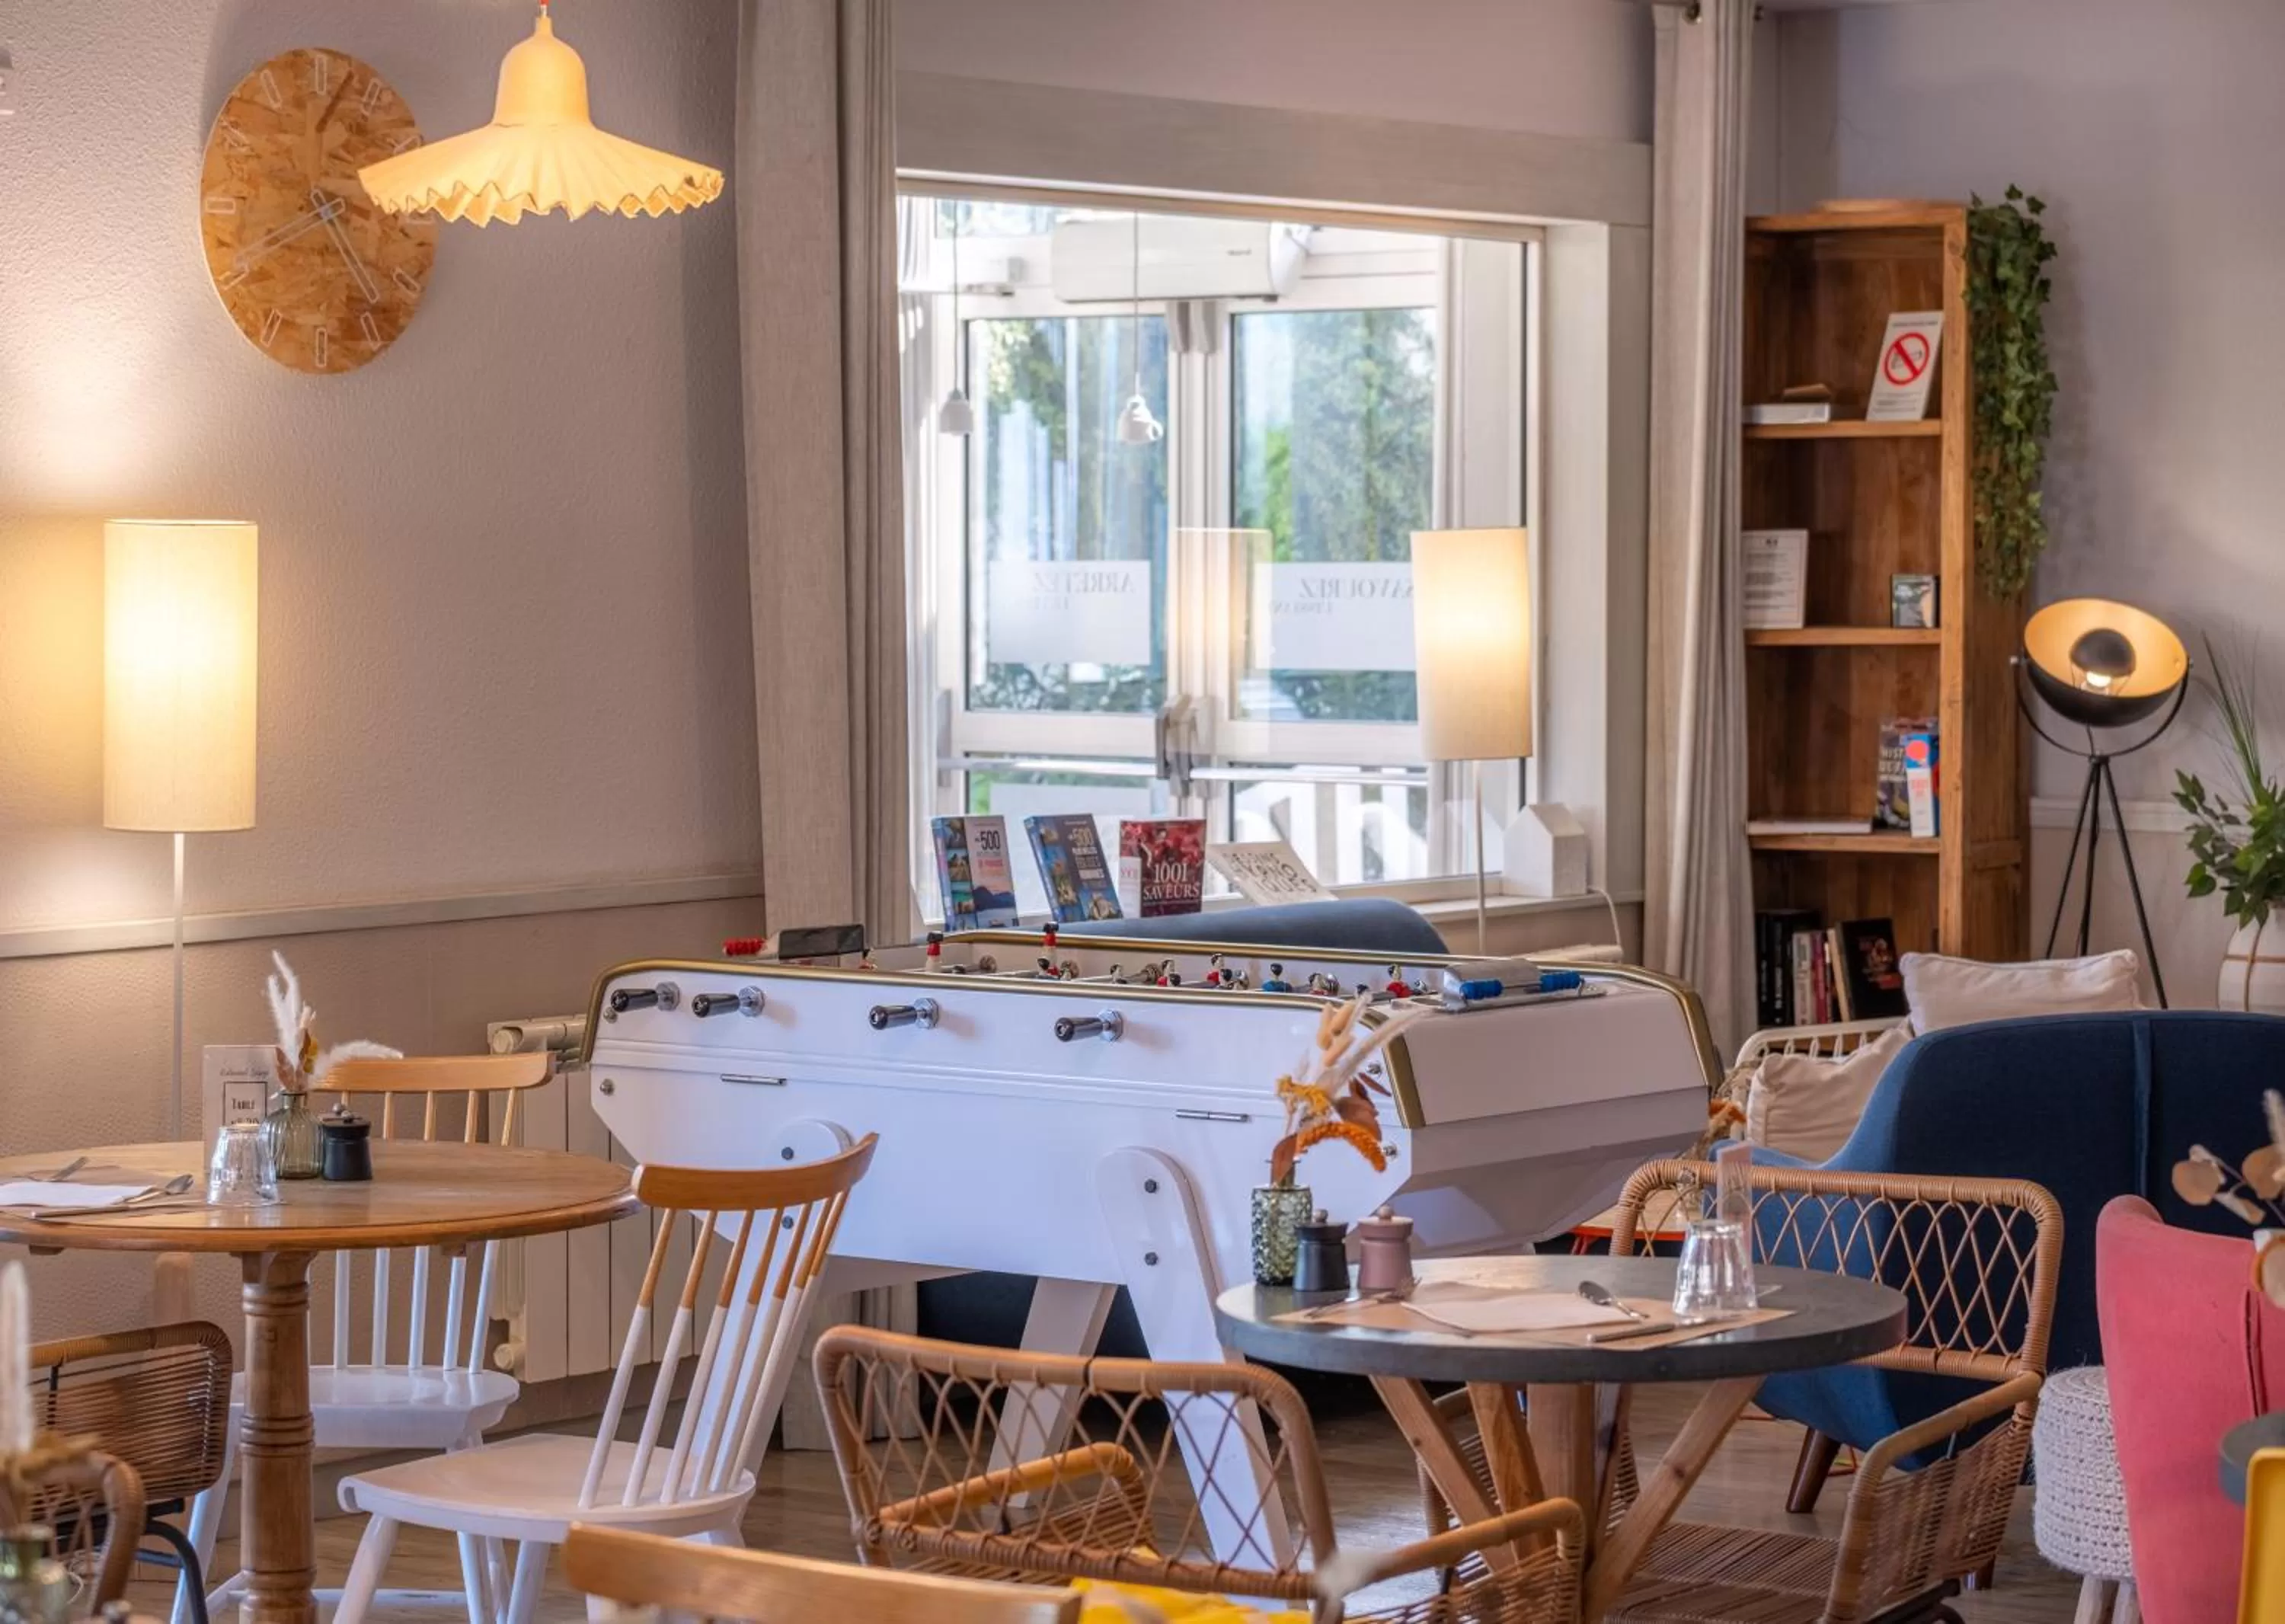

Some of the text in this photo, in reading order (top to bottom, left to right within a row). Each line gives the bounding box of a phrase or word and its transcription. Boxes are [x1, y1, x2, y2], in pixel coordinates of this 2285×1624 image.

[980, 830, 1001, 851] 500
[1153, 862, 1190, 884] 1001
[1142, 883, 1200, 900] SAVEURS
